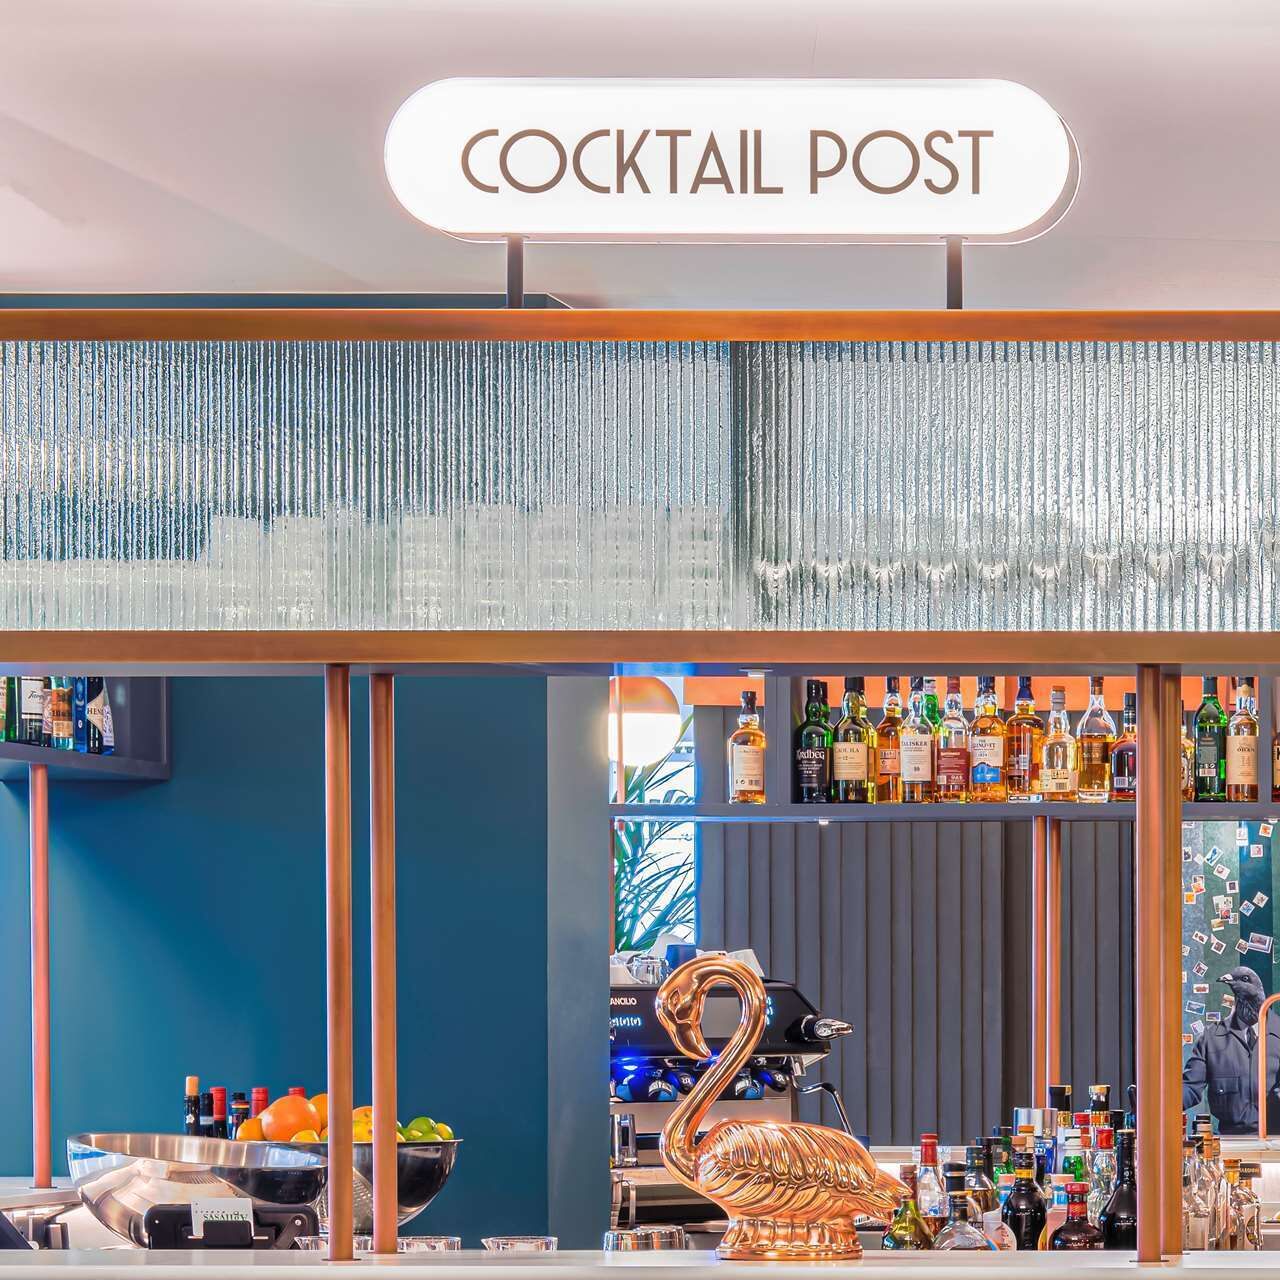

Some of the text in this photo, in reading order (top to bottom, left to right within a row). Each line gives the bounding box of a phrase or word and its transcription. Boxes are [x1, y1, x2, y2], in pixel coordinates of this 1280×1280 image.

[461, 129, 994, 195] COCKTAIL POST
[610, 997, 638, 1006] ANCILIO
